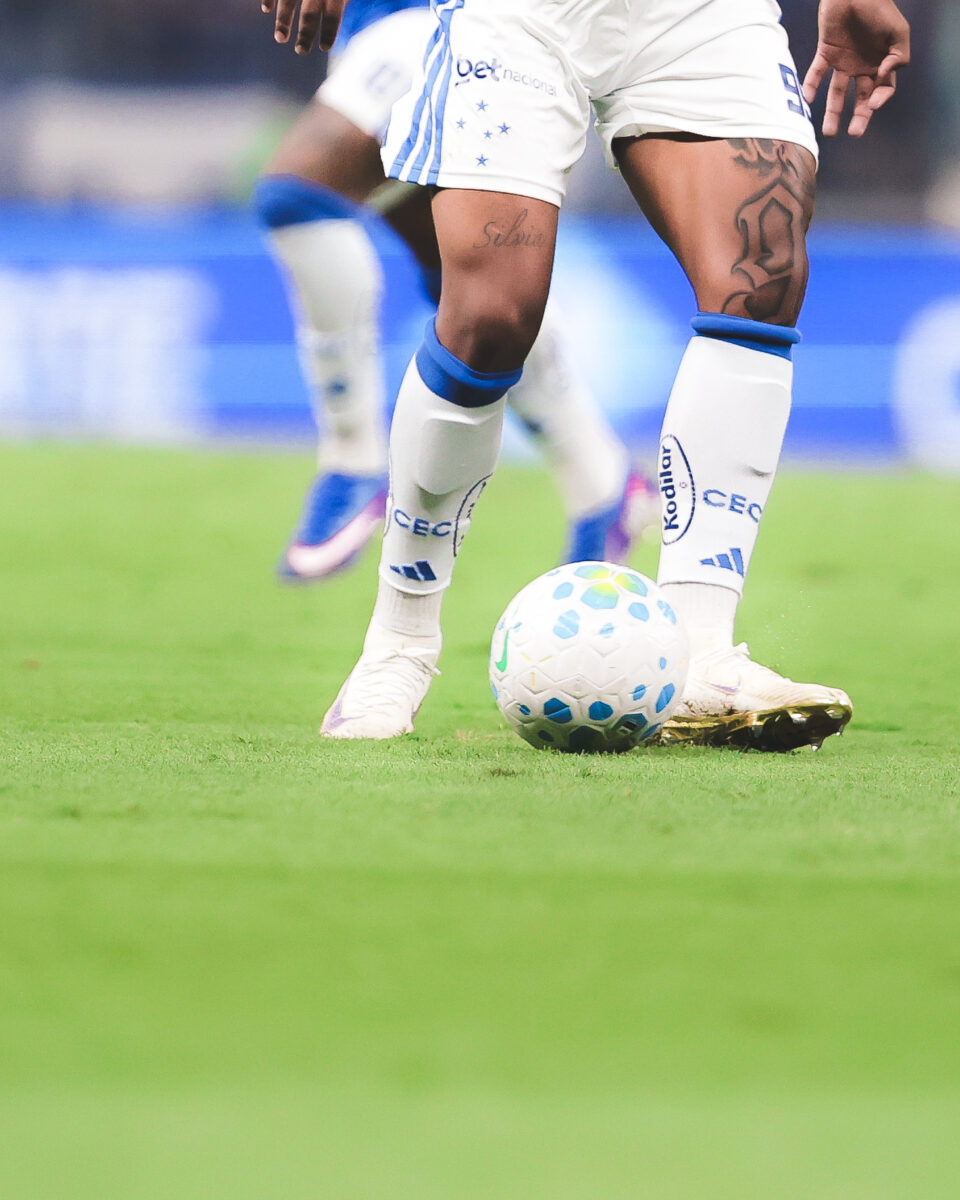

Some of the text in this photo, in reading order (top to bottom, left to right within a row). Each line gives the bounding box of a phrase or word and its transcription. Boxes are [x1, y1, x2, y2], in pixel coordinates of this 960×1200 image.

[660, 445, 679, 530] Kodilar
[394, 509, 451, 537] CEC
[703, 489, 762, 523] CEC
